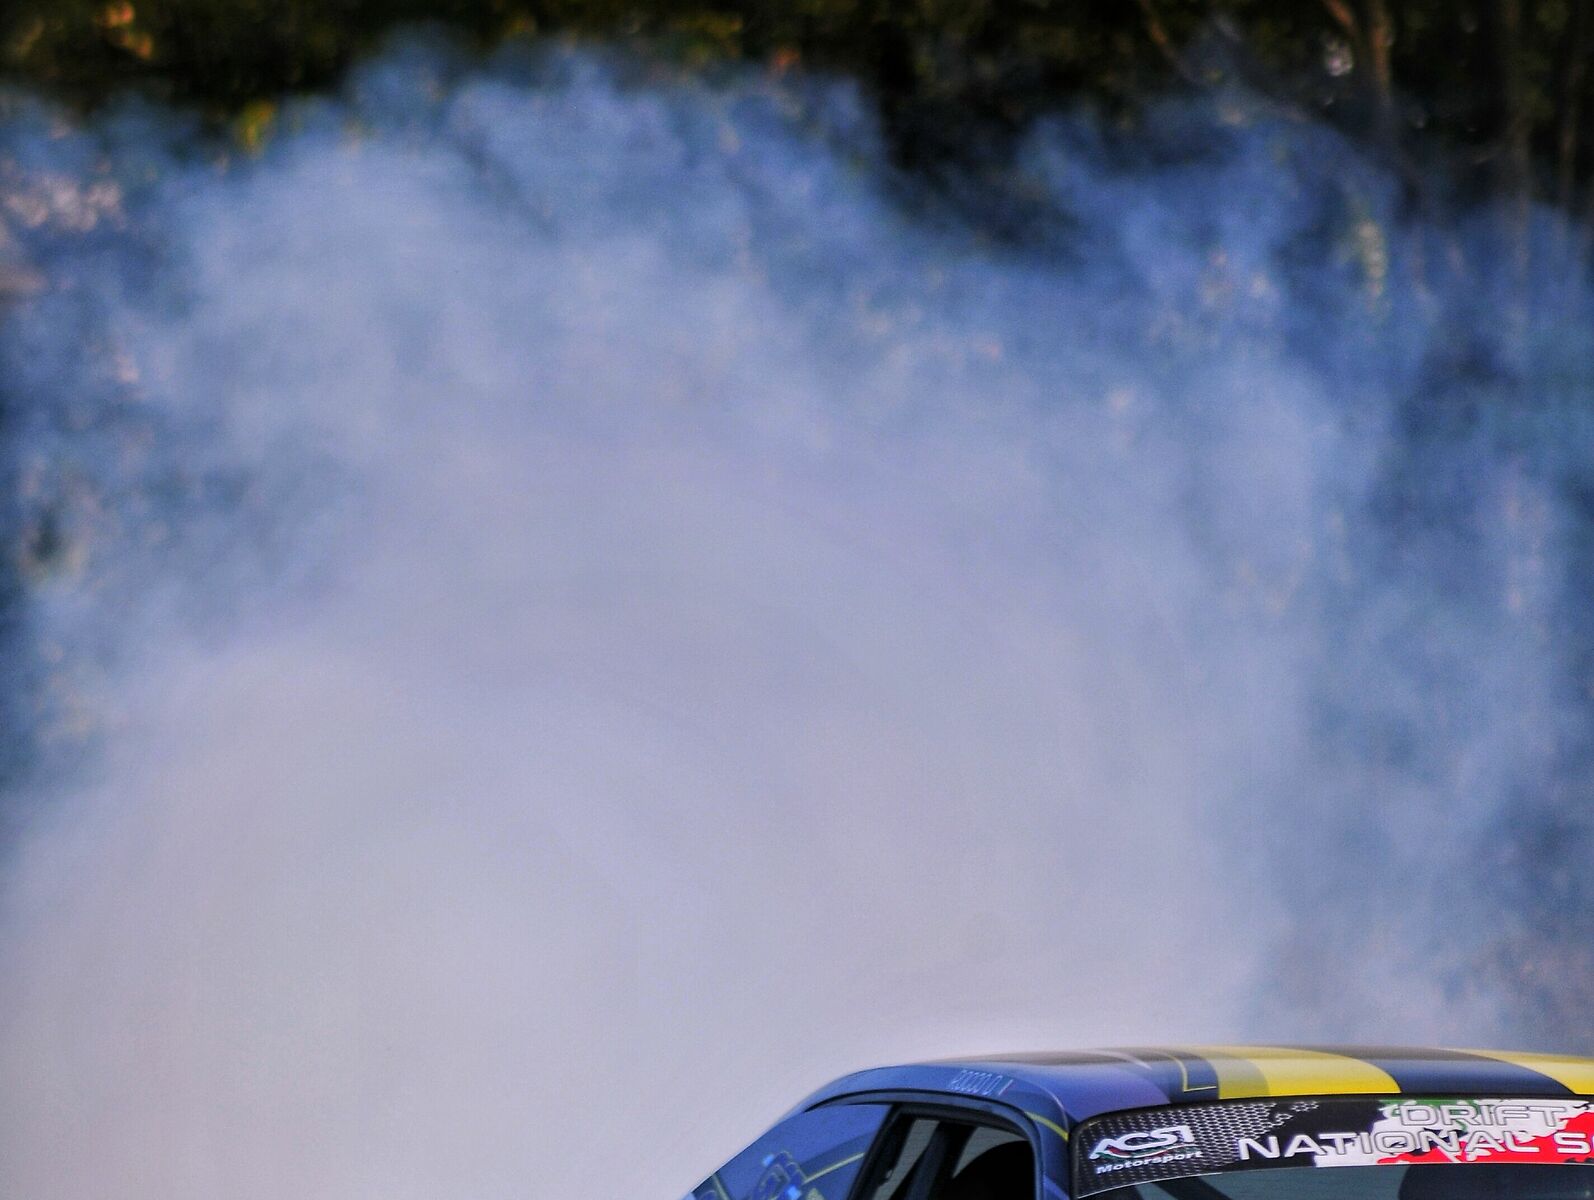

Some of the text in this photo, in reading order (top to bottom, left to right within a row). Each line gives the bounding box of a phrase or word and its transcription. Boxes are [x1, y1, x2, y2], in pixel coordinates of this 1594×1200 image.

[1400, 1105, 1567, 1128] DRIFT
[1088, 1124, 1195, 1159] ACSI
[1238, 1131, 1594, 1161] NATIONAL S
[1095, 1150, 1203, 1175] Motorsport
